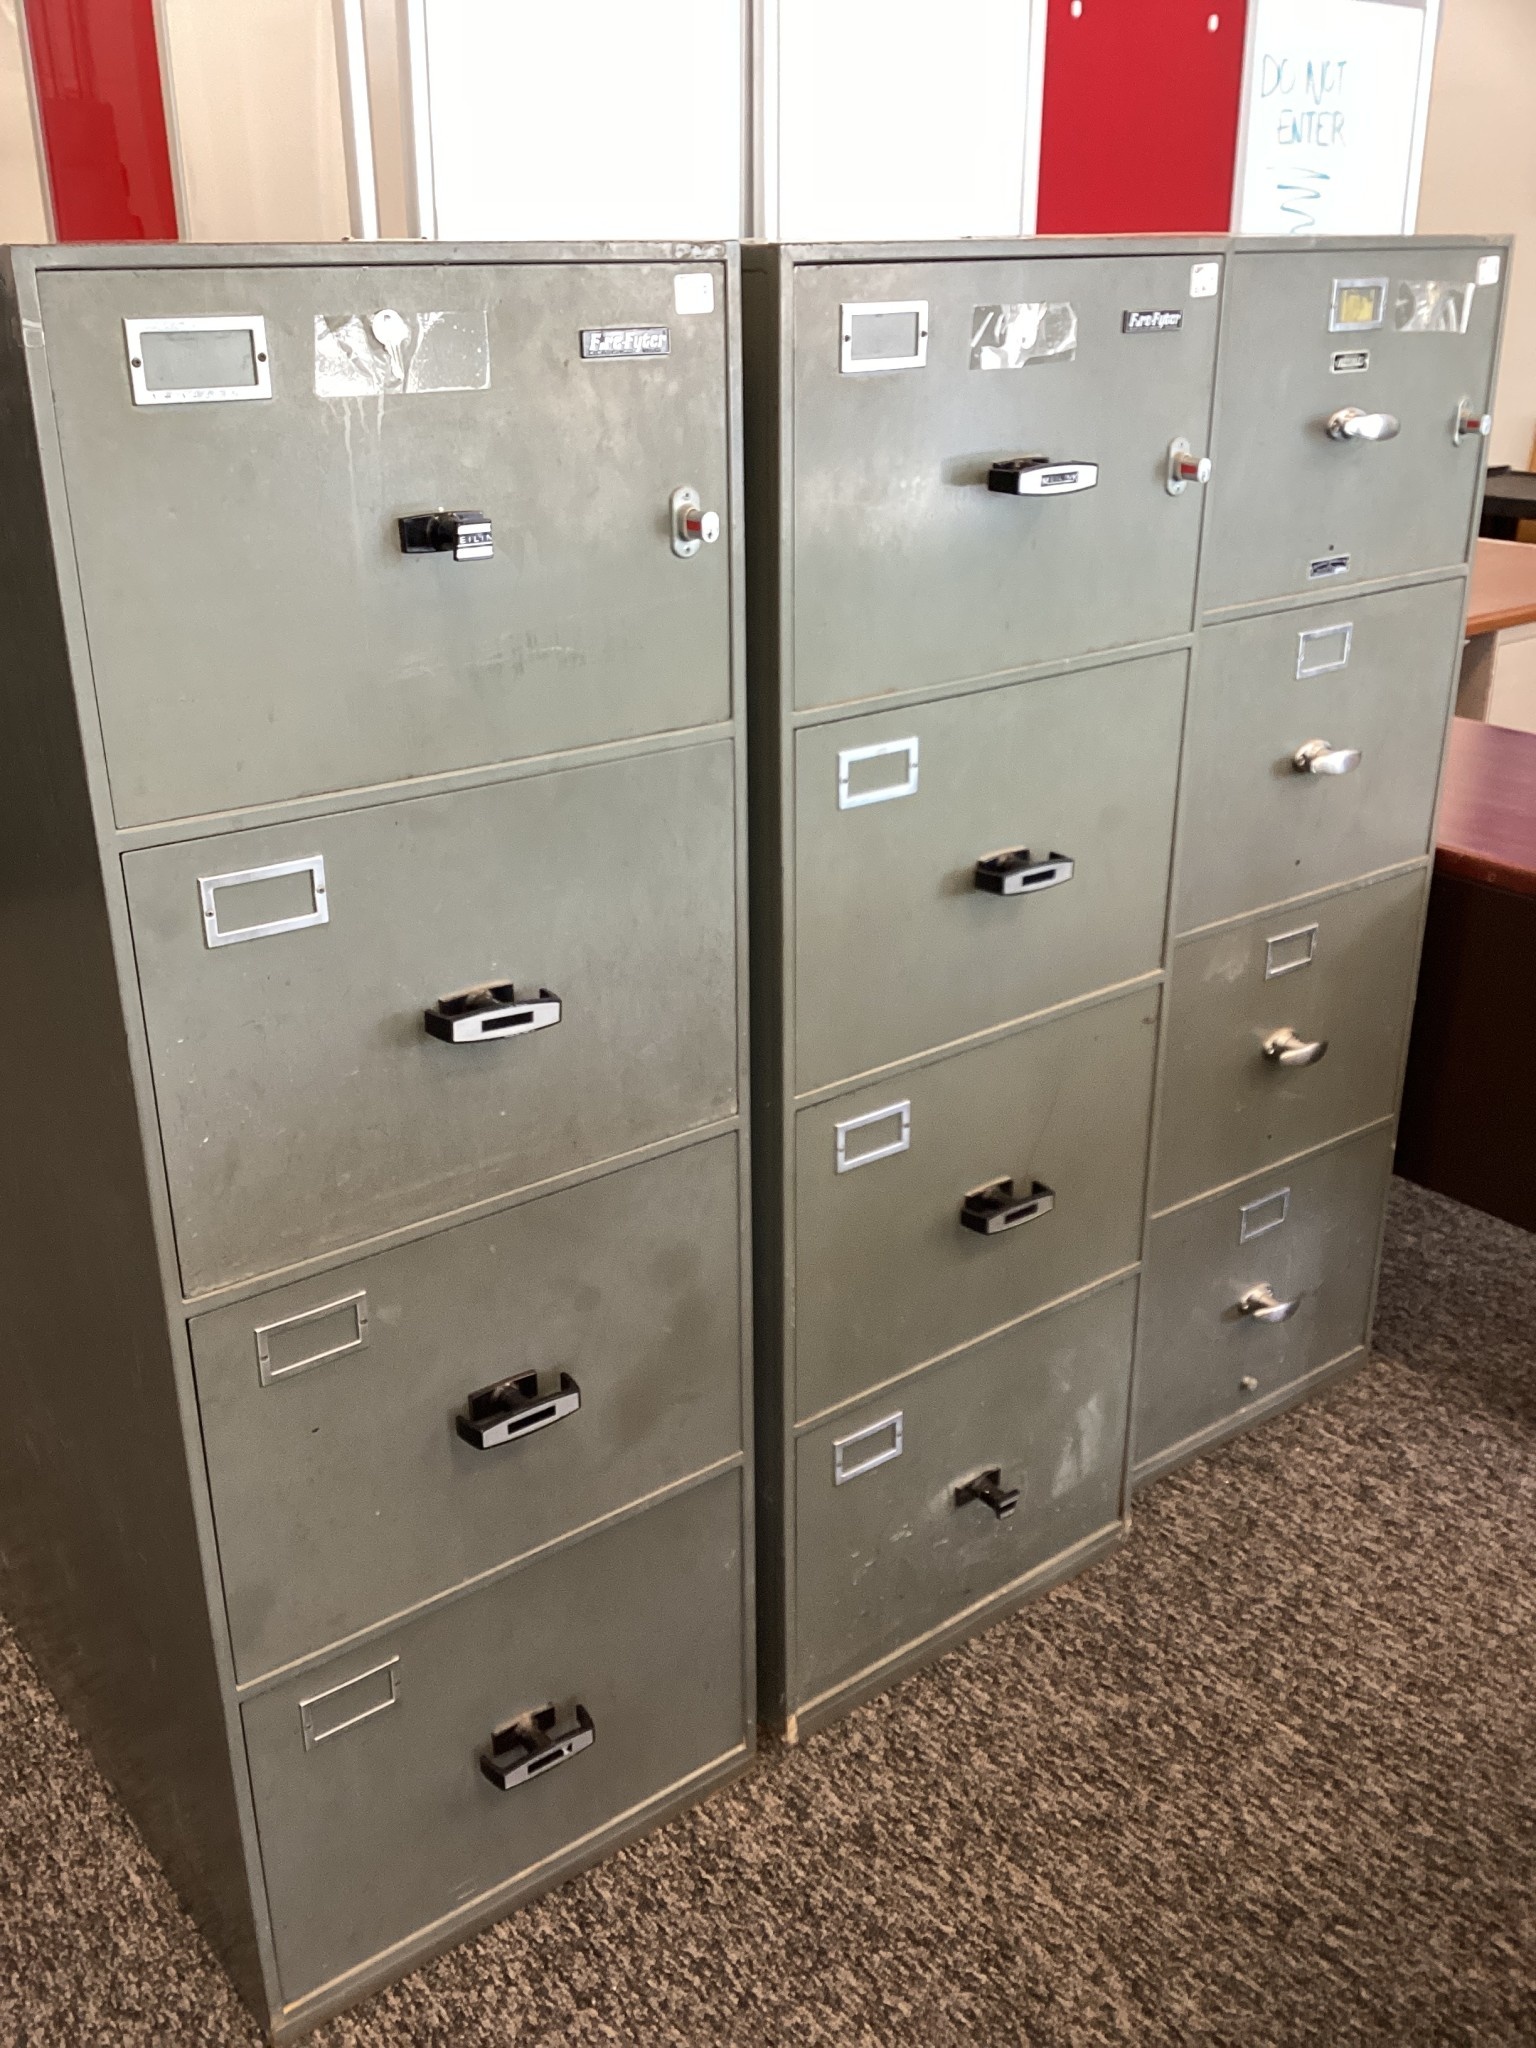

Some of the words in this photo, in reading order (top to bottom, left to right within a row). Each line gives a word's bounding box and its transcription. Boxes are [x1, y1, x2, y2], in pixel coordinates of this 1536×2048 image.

[1261, 53, 1296, 98] DO
[1305, 60, 1347, 105] NOT
[1276, 108, 1346, 147] ENTER
